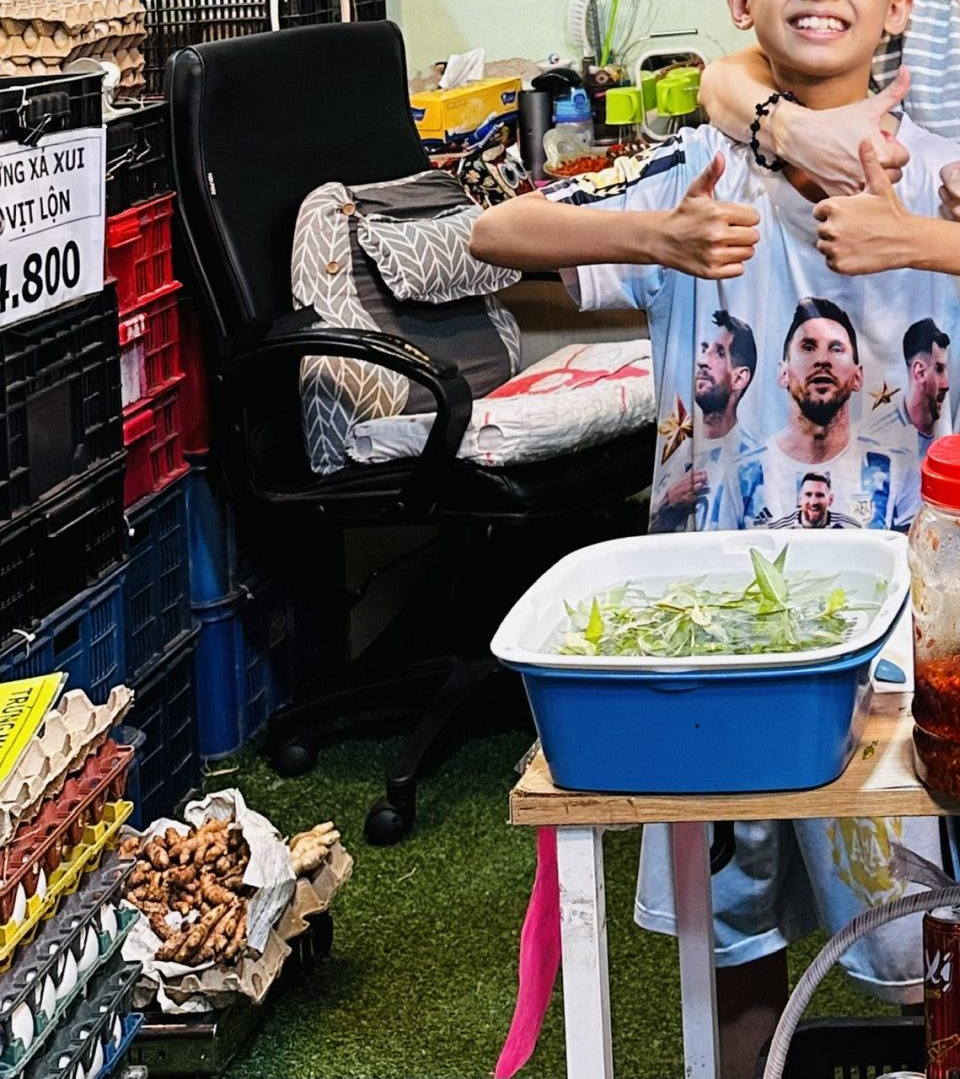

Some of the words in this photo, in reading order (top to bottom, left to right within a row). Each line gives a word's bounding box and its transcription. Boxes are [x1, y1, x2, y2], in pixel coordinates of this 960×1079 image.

[28, 146, 49, 180] XẢ
[53, 147, 85, 175] XUI
[6, 200, 35, 233] VỊT
[39, 186, 71, 223] LỘN
